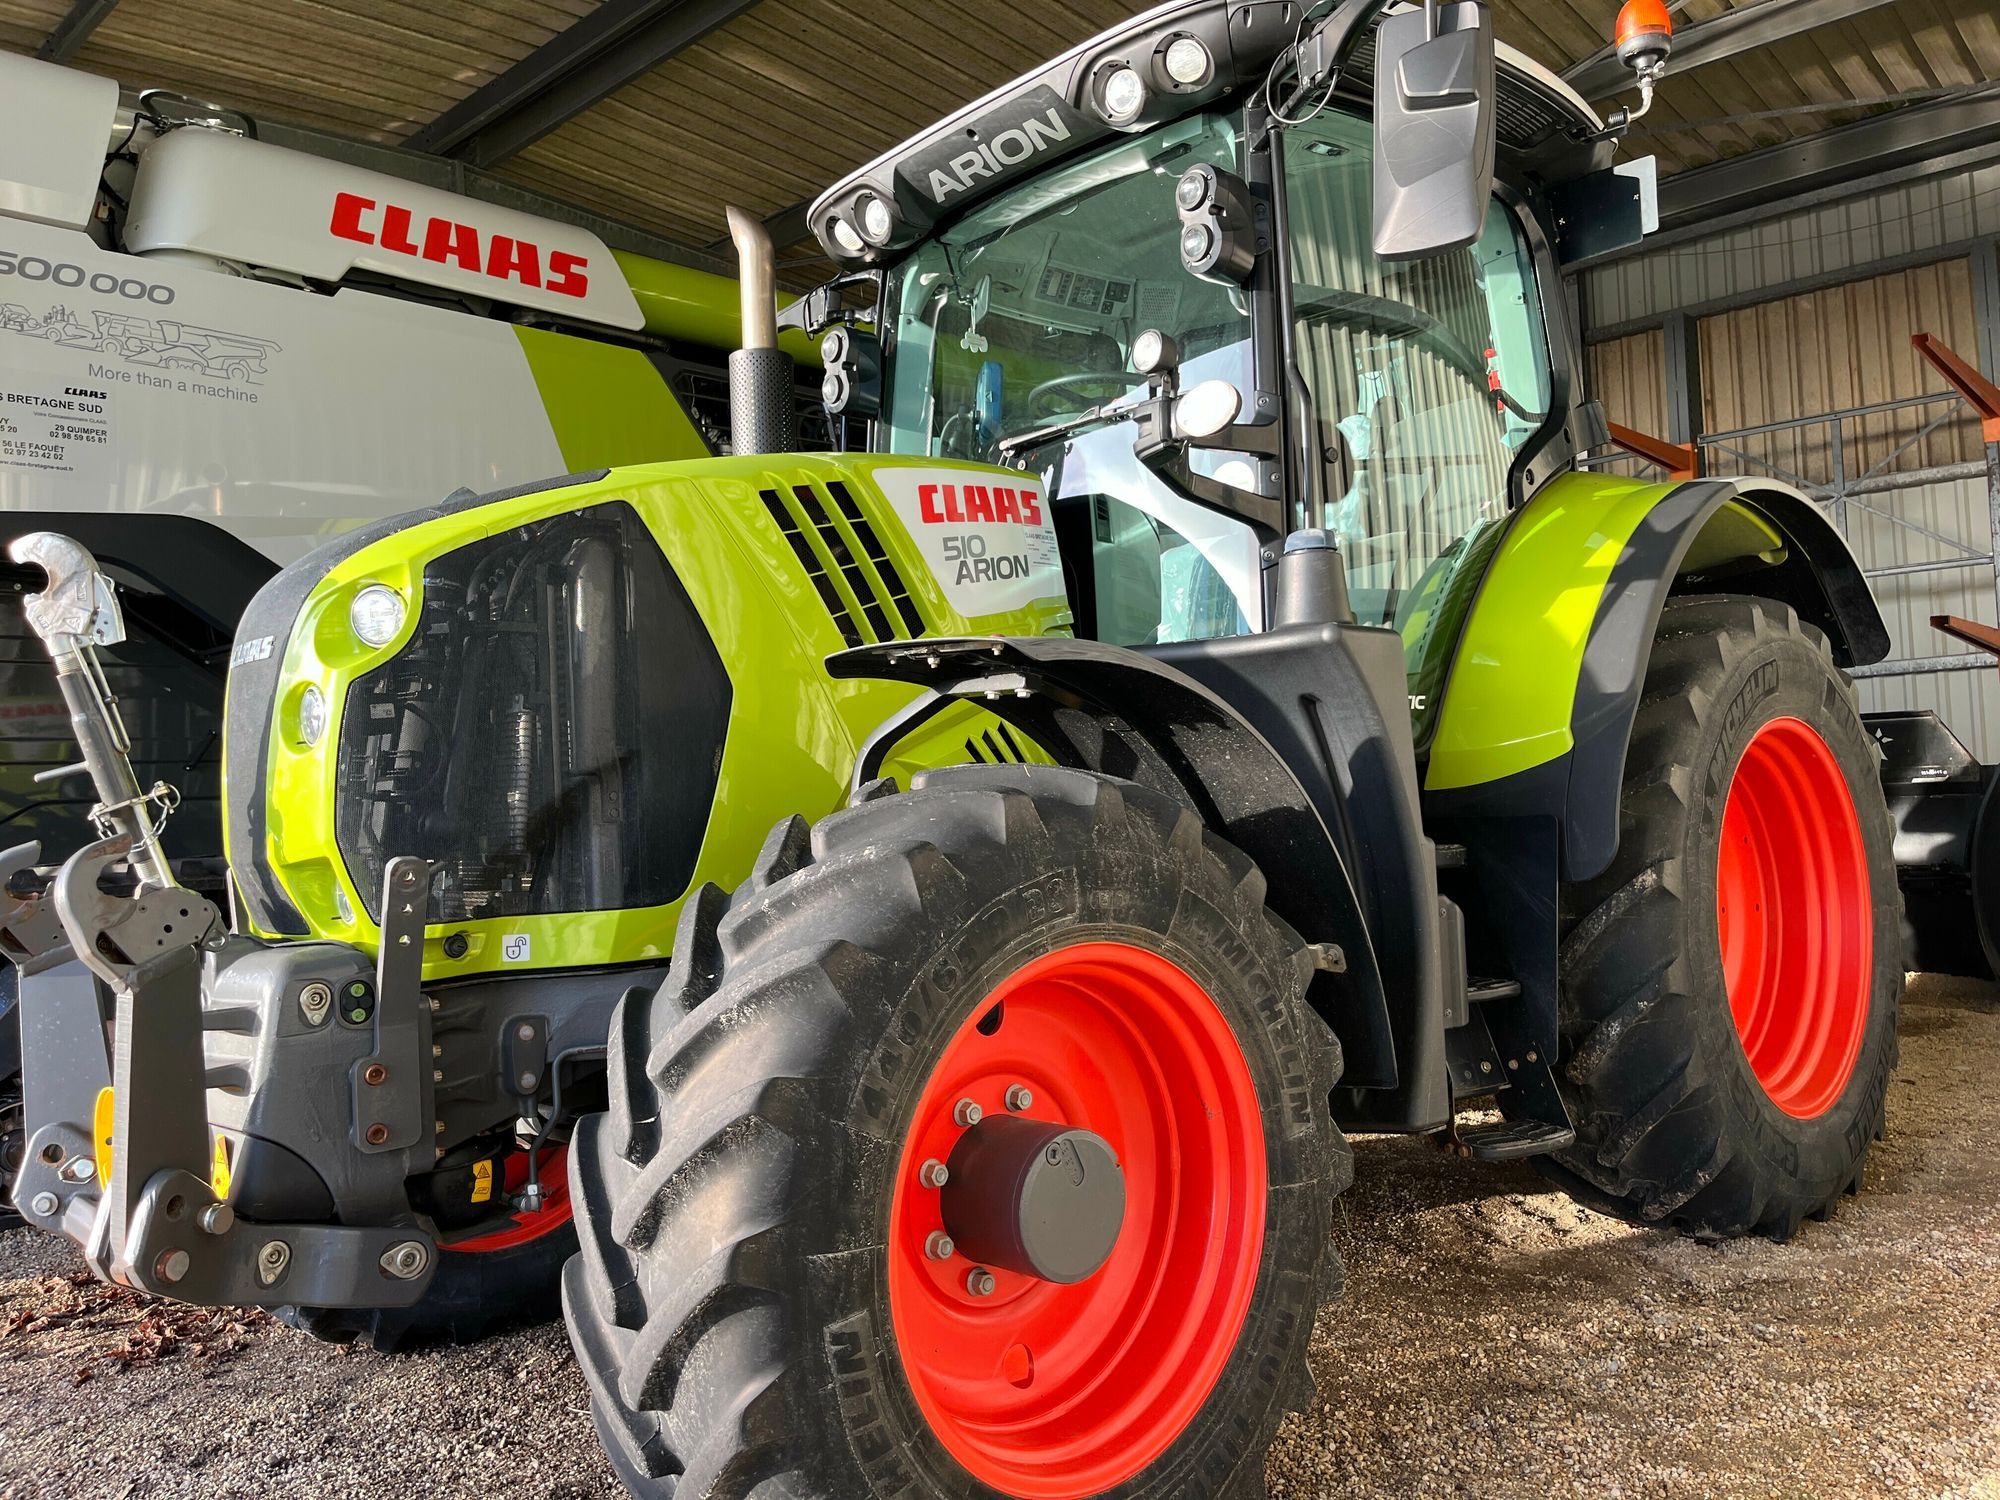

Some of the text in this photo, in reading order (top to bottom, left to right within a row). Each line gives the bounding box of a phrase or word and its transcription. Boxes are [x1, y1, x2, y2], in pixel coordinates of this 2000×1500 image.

[928, 107, 1072, 204] ARION
[330, 192, 588, 298] CLAAS
[64, 387, 107, 400] CLAAS
[88, 363, 258, 403] More than a machine
[7, 393, 75, 411] BRETAGNE
[78, 403, 103, 414] SUD
[7, 425, 18, 433] 20
[67, 425, 107, 437] QUIMPER
[15, 441, 26, 449] LE
[918, 484, 1042, 526] CLAAS
[943, 534, 986, 562] 510
[955, 555, 1030, 586] ARION
[1213, 926, 1311, 1124] MICHELIN
